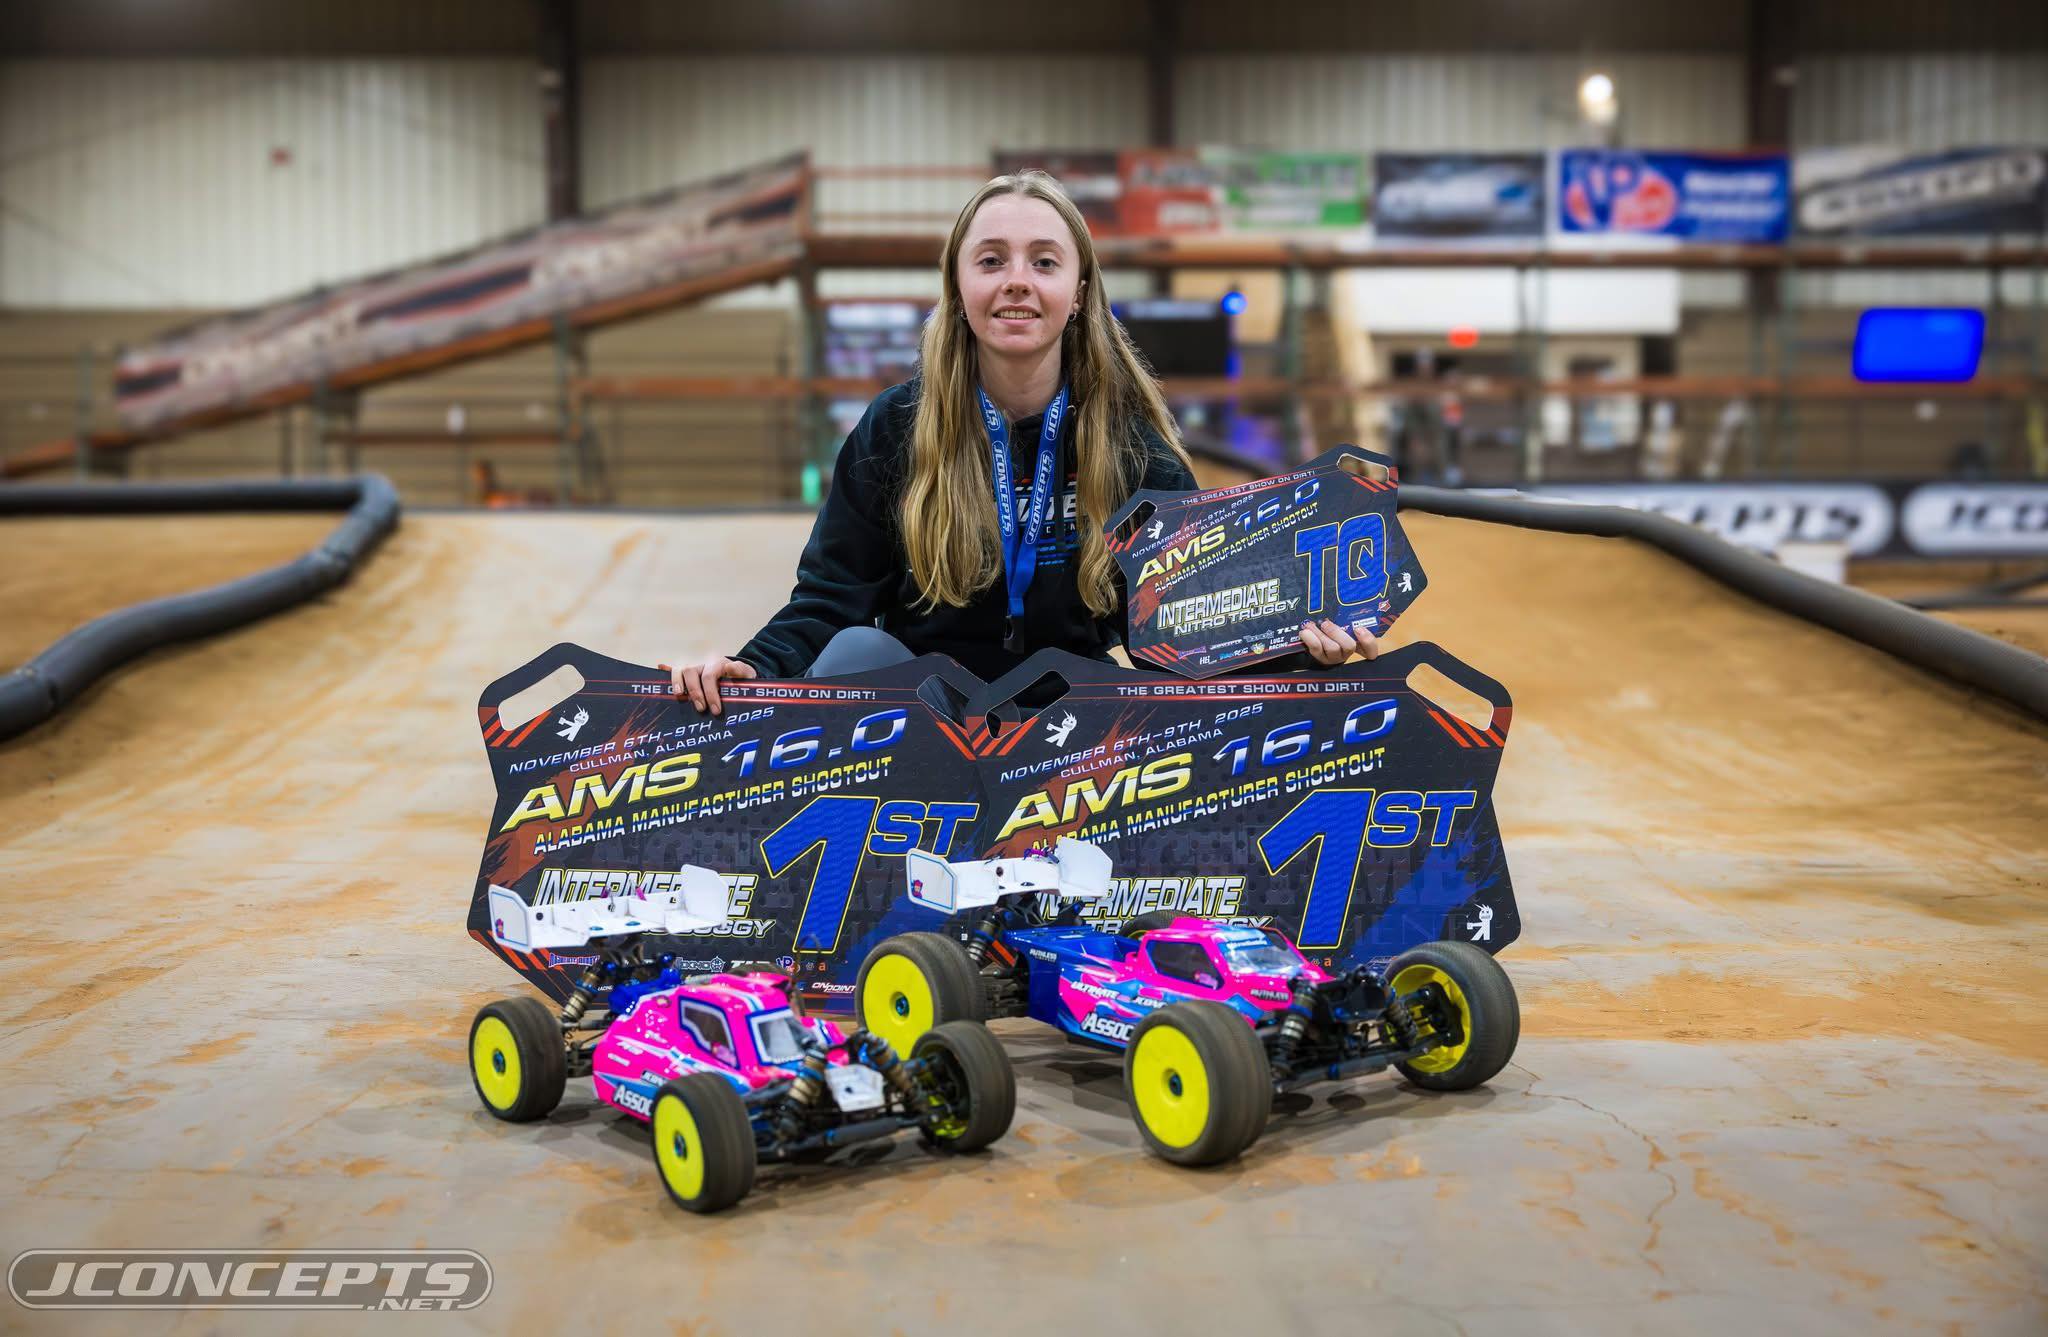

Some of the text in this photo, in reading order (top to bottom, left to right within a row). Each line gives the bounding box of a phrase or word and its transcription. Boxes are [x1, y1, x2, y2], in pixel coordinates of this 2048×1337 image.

[993, 445, 1013, 533] JCONCEPTS
[1028, 451, 1052, 542] JCONCEPTS
[1181, 494, 1199, 506] THE
[1201, 486, 1246, 502] GREATEST
[1249, 478, 1276, 490] SHOW
[1278, 475, 1291, 484] ON
[1200, 509, 1237, 531] ALABAMA
[1132, 530, 1182, 559] NOVEMBER
[1136, 477, 1321, 588] AMS 16.0
[1154, 501, 1319, 594] ALABAMA MANUFACTURER SHOOTOUT
[1294, 512, 1390, 614] TQ
[1157, 577, 1281, 630] INTERMEDIATE
[1173, 613, 1228, 637] NITRO
[1228, 597, 1300, 624] TRUGGY
[632, 684, 661, 694] THE
[755, 687, 805, 698] SHOW
[809, 689, 832, 699] ON
[836, 690, 876, 700] DIRT!
[1117, 681, 1366, 696] THE GREATEST SHOW ON DIRT!
[499, 708, 909, 832] AMS 16.0
[509, 706, 775, 775] NOVEMBER 6TH-9TH 2025
[655, 730, 733, 755] ALABAMA
[993, 698, 1400, 842] AMS 16.0
[1000, 702, 1264, 783] NOVEMBER 6TH-9TH 2025
[1145, 728, 1224, 756] ALABAMA
[534, 755, 893, 855] ALABAMA MANUFACTURER SHOOTOUT
[1126, 776, 1278, 836] MANUFACTURER
[1285, 747, 1386, 793] SHOOTOUT
